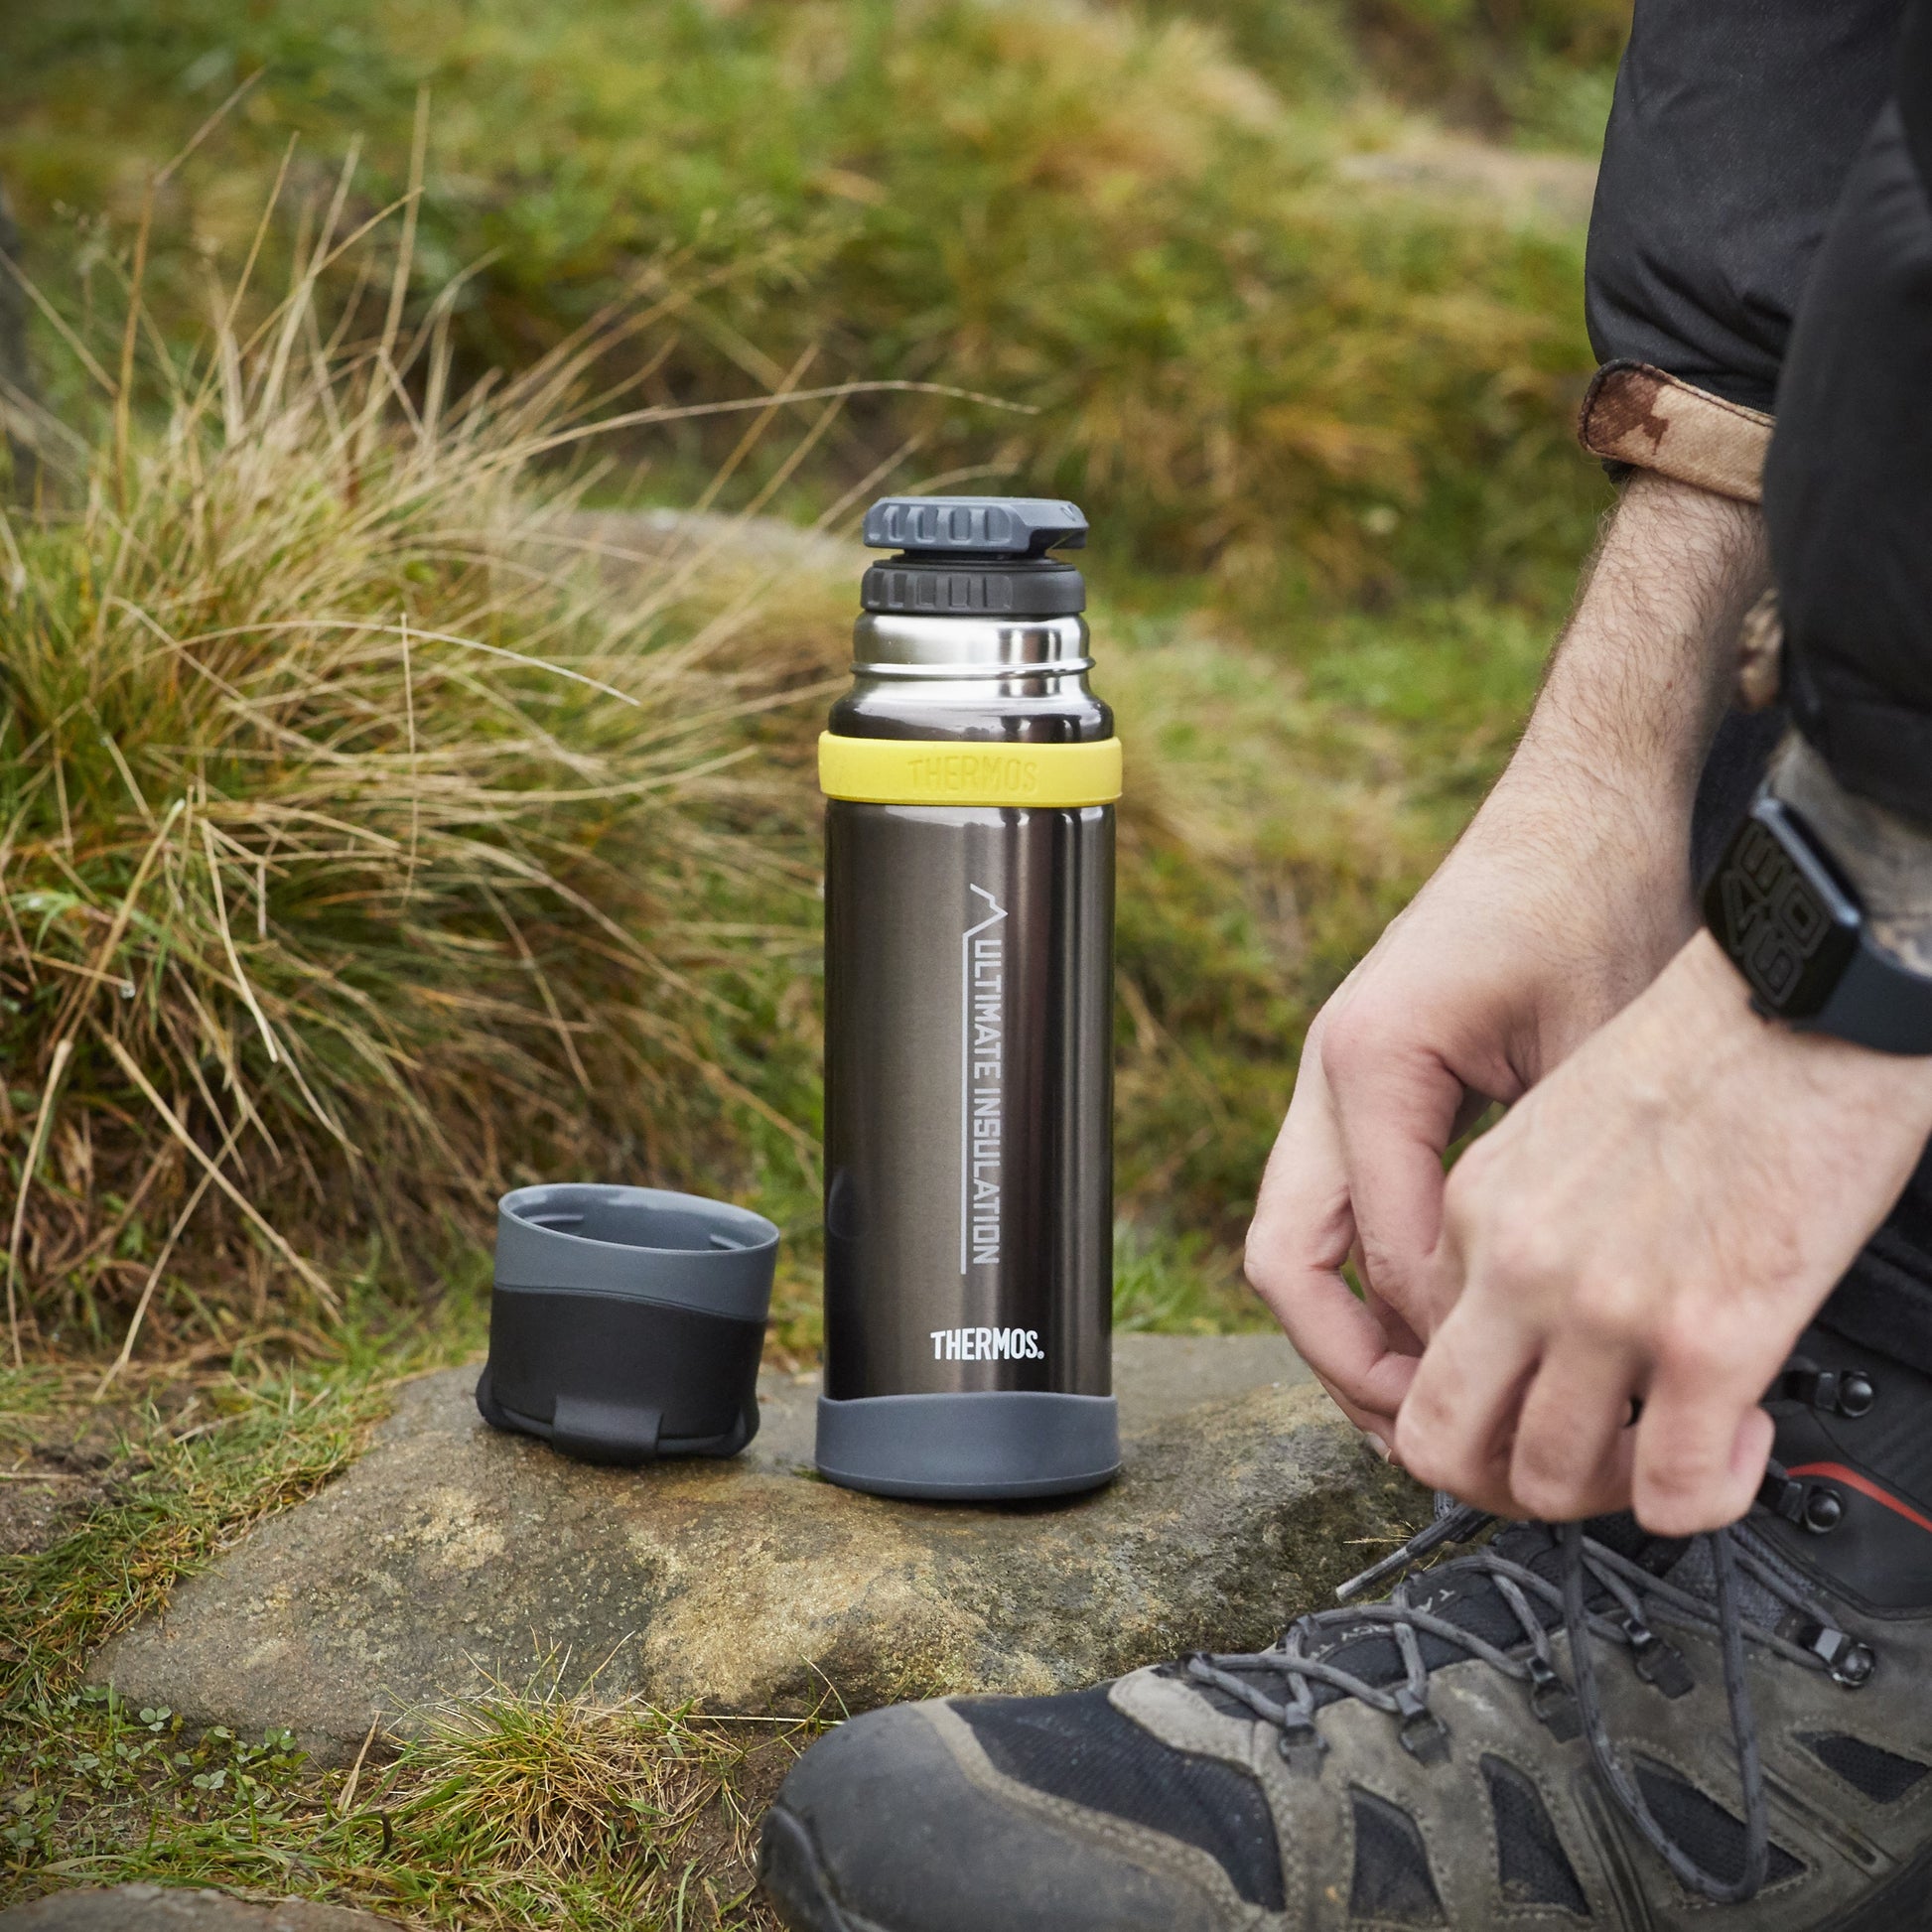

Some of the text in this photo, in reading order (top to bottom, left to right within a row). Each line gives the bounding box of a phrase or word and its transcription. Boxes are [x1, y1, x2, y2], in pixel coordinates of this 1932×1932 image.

[906, 755, 1038, 792] THERMOS
[972, 938, 1002, 1265] ULTIMATE INSULATION
[929, 1327, 1038, 1360] THERMOS
